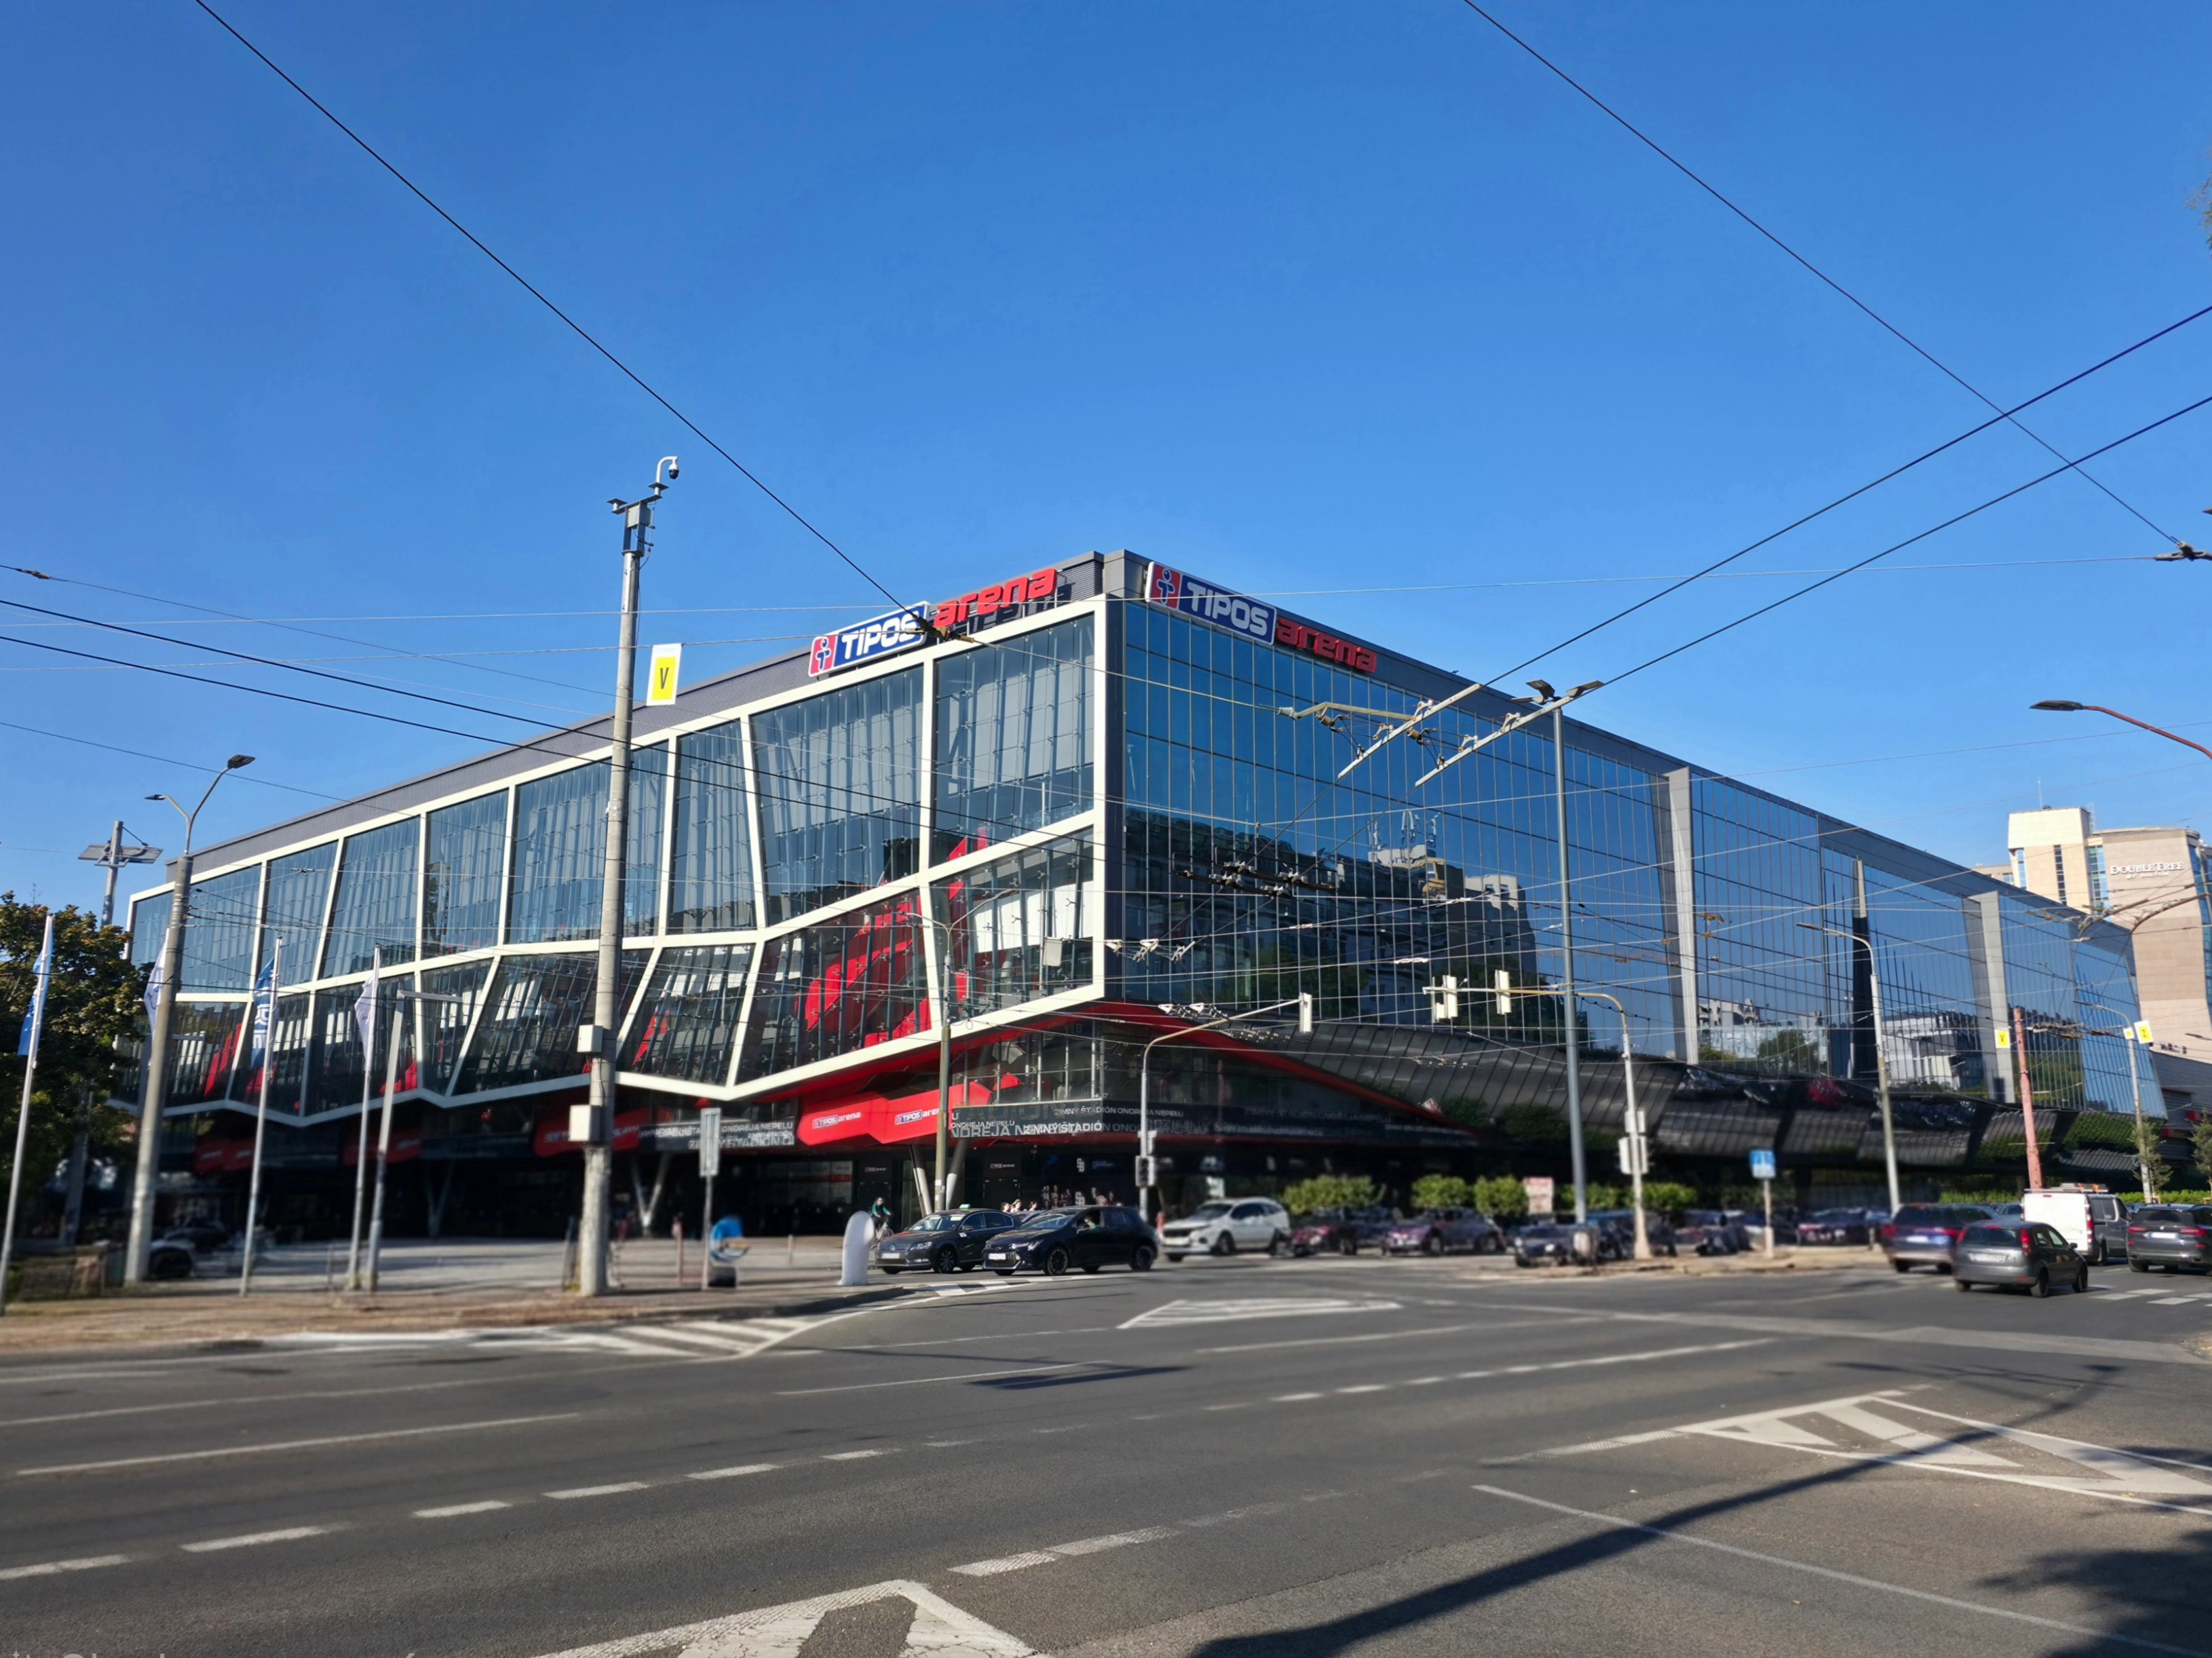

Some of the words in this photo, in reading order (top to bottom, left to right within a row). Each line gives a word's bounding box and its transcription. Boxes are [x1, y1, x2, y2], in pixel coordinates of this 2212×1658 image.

[841, 611, 919, 660] TIPOS
[934, 568, 1058, 628] arena
[1187, 581, 1269, 636] TIPOS
[1276, 617, 1377, 673] arena
[660, 667, 669, 690] V
[818, 1117, 837, 1127] TIPOS
[837, 1112, 862, 1123] arena
[902, 1111, 921, 1123] TIPOS
[922, 1108, 940, 1118] are
[1155, 1109, 1184, 1118] NEPELU
[721, 1123, 760, 1133] ONDREJA
[760, 1121, 793, 1130] NEPELU
